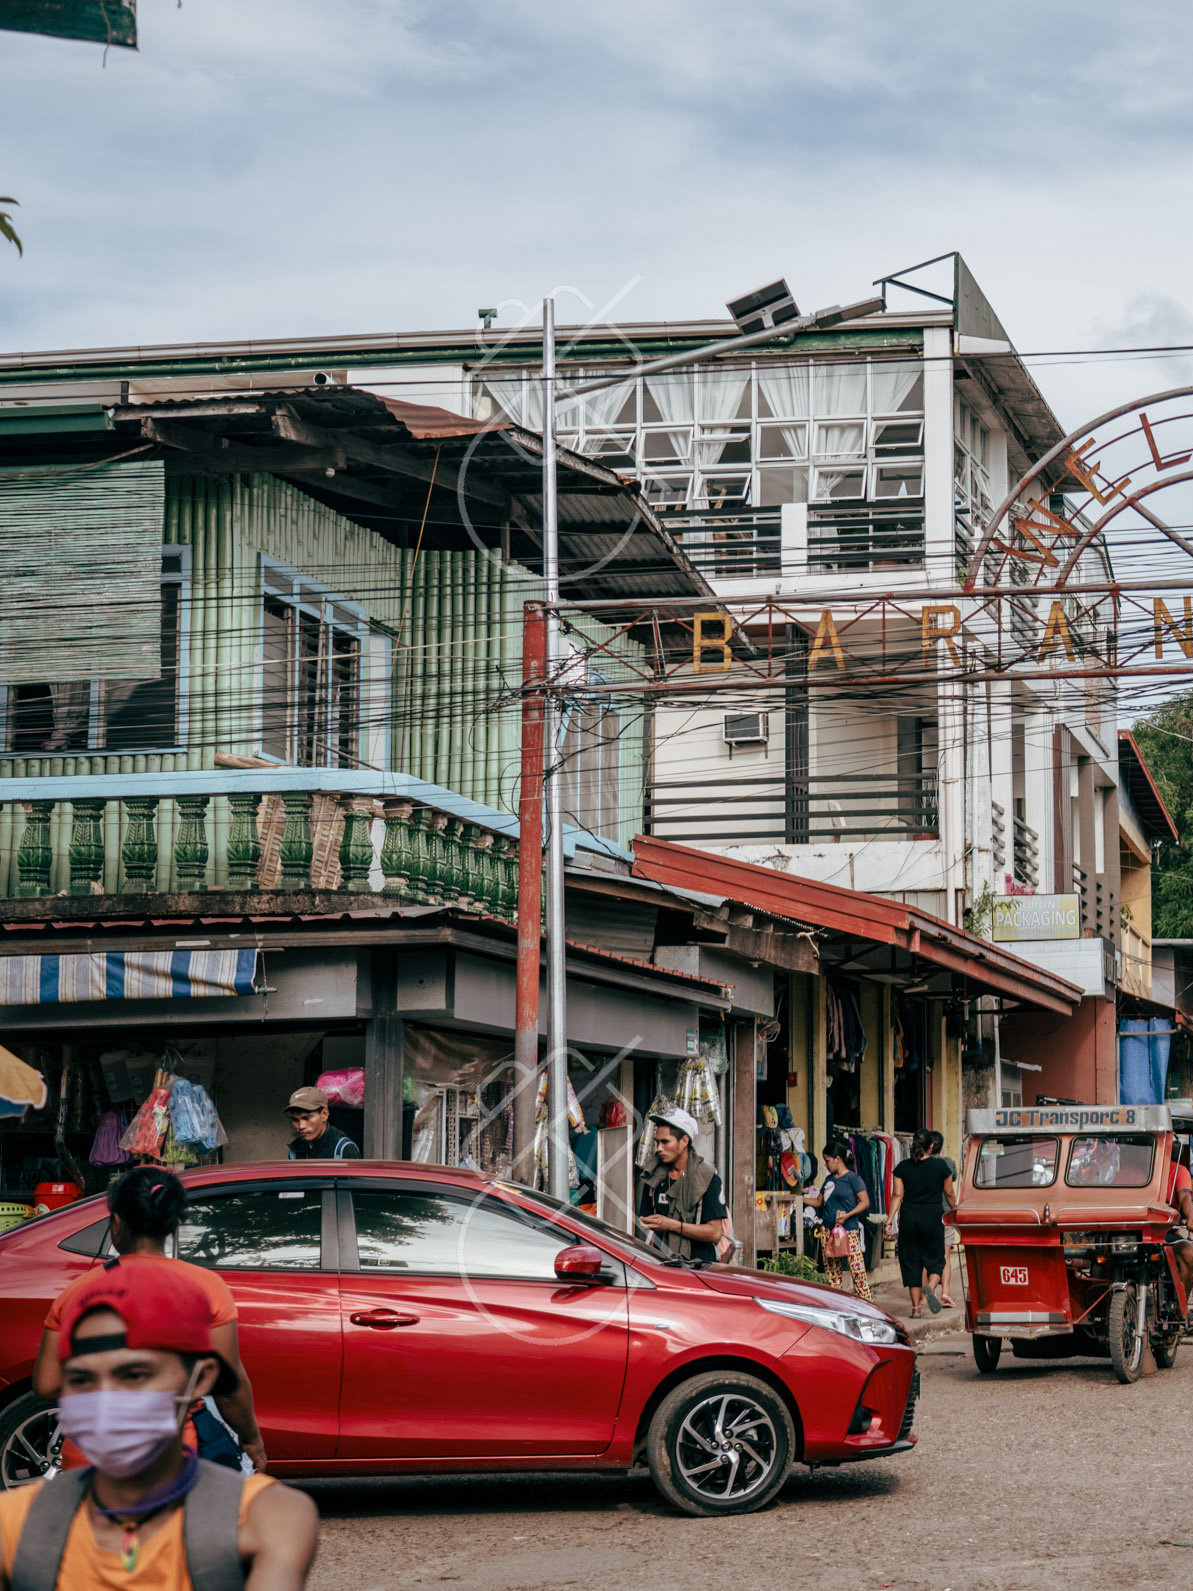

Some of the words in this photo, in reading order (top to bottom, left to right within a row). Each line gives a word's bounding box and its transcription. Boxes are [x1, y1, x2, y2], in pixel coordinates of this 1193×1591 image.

[996, 909, 1076, 927] PACKAGING
[995, 1110, 1022, 1127] JC
[1126, 1109, 1136, 1125] 8
[1002, 1269, 1027, 1284] 645
